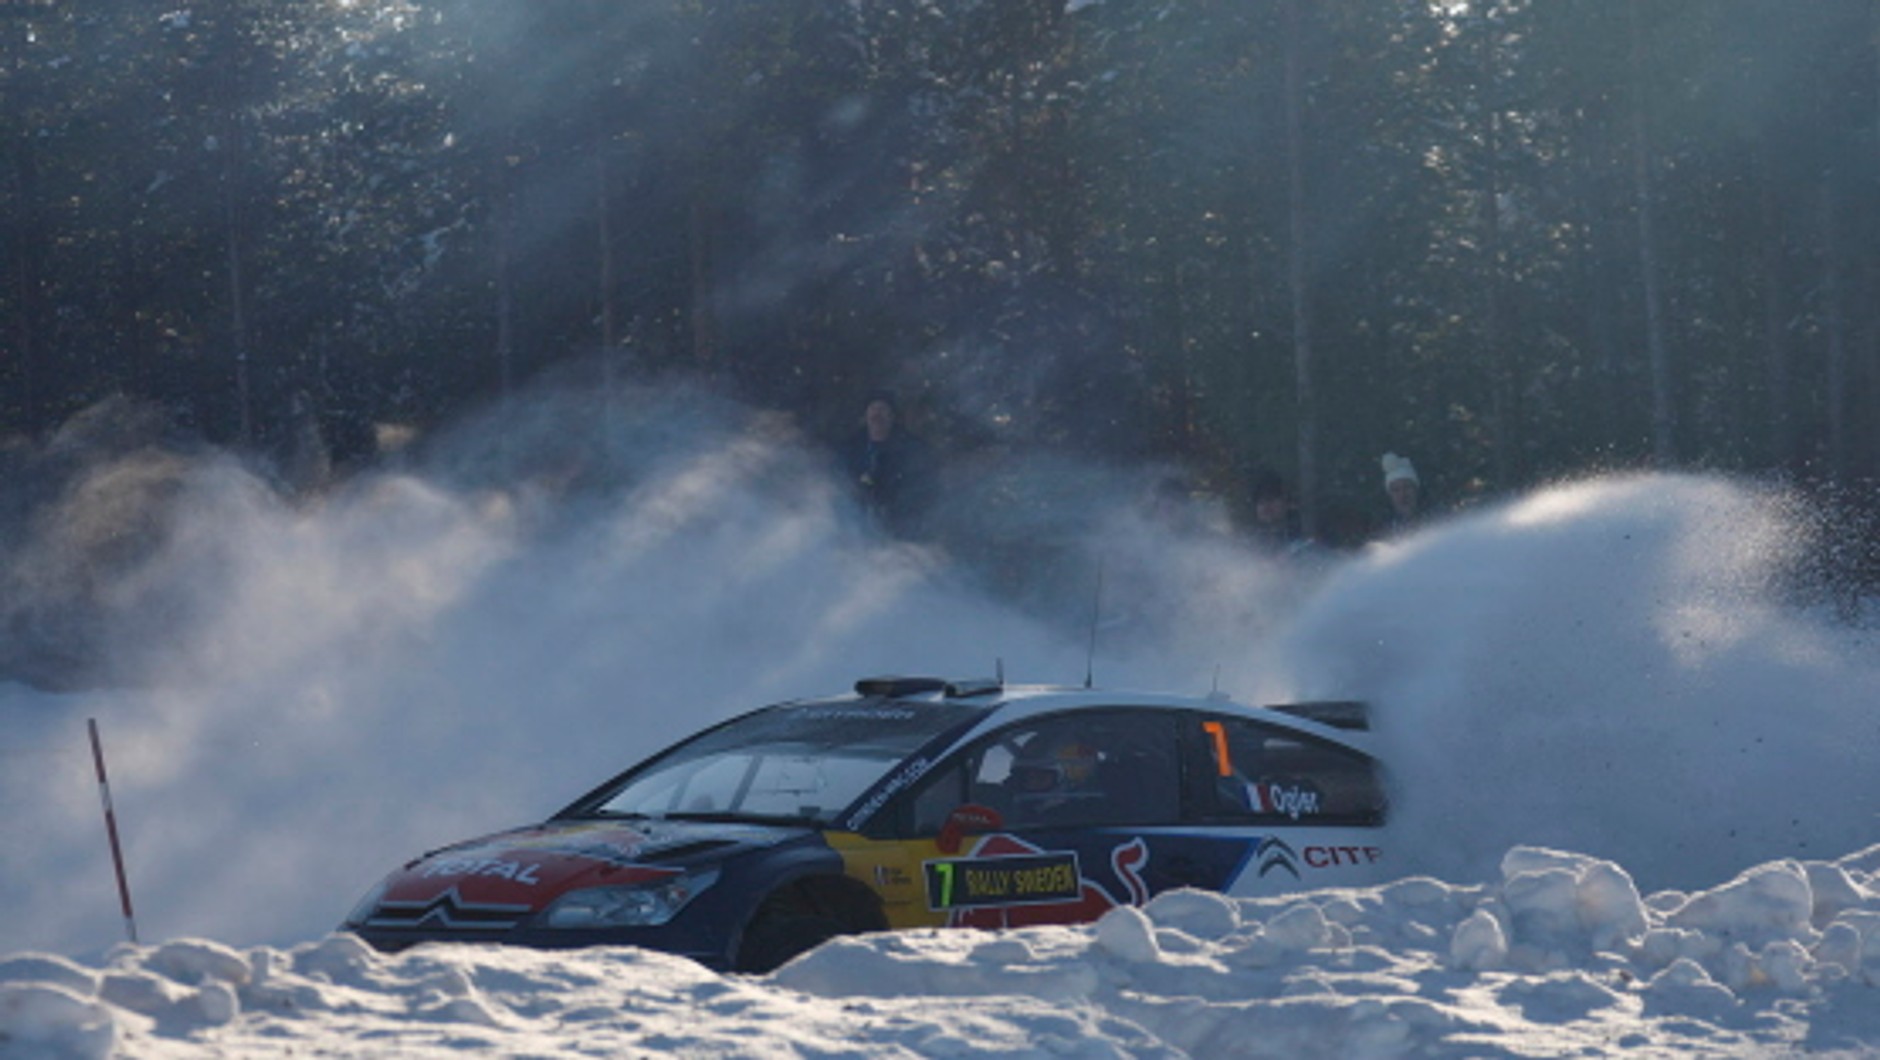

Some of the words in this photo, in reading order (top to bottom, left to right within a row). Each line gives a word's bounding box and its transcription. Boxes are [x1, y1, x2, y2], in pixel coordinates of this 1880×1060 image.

[1202, 721, 1232, 777] 7
[424, 858, 542, 885] TOTAL
[934, 863, 953, 907] 7
[965, 868, 1010, 896] RALLY
[1013, 862, 1075, 893] SWEDEN
